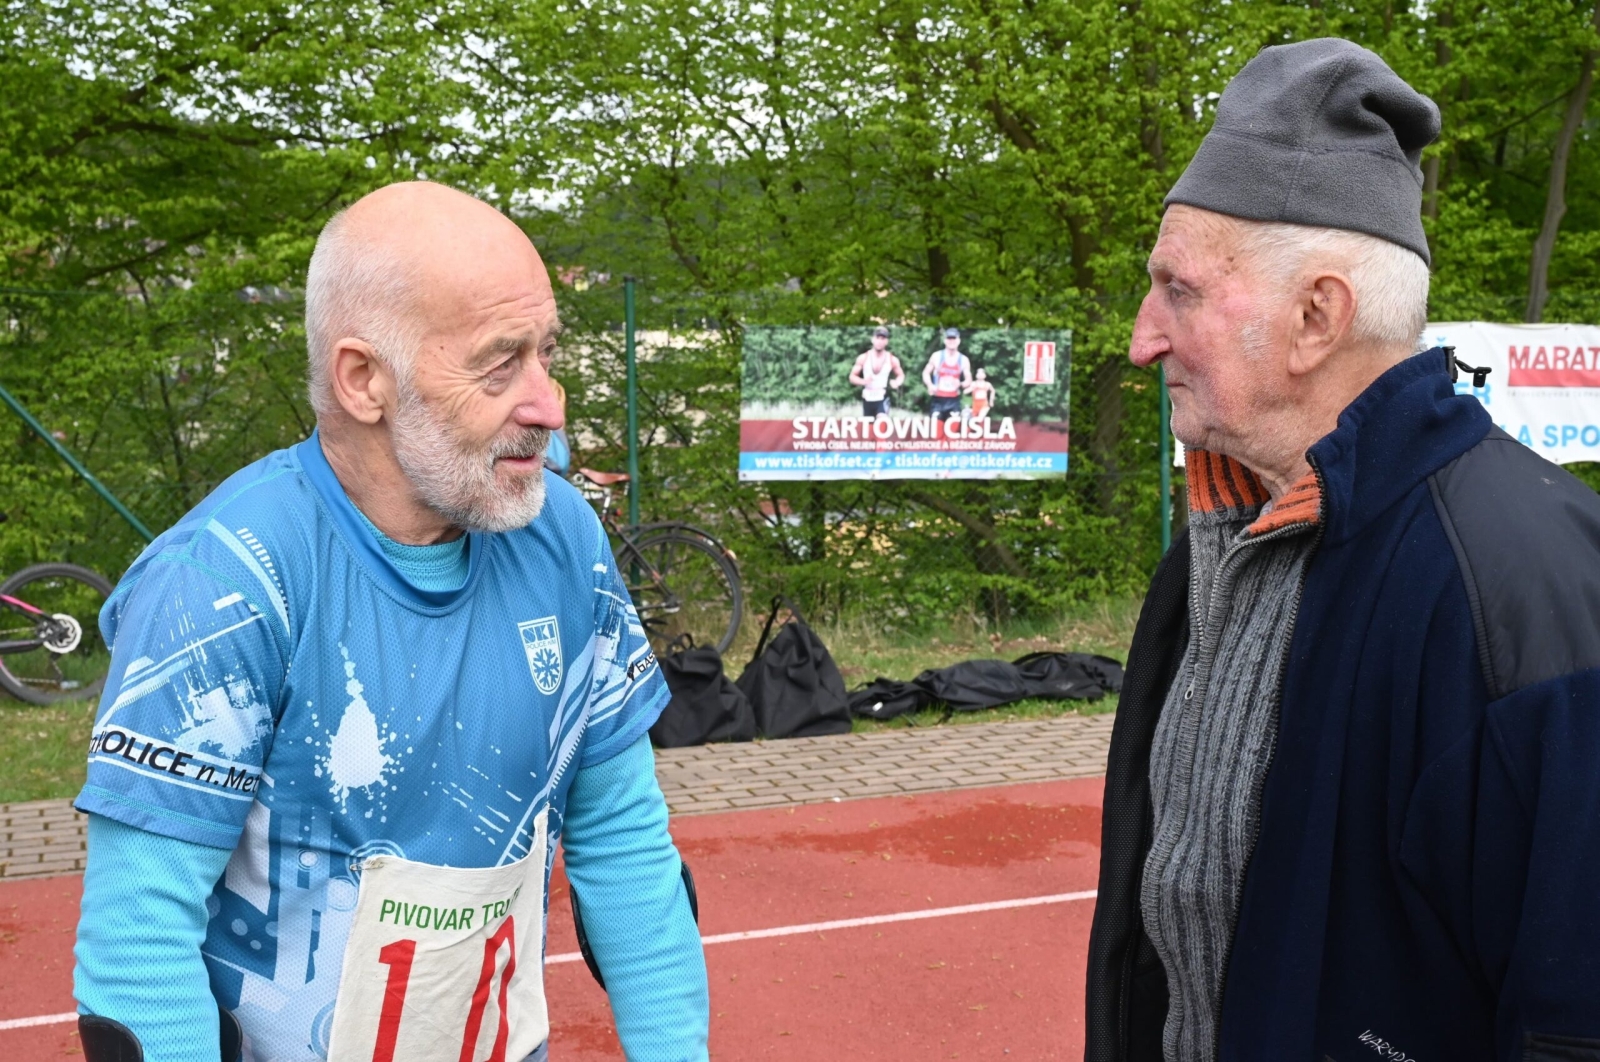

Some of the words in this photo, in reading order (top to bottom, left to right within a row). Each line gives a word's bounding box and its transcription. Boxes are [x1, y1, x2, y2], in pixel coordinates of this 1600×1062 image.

[792, 411, 940, 439] STARTOVNÍ
[943, 411, 1017, 440] ČÍSLA
[1543, 424, 1600, 448] SPO
[754, 454, 882, 468] www.tiskofset.cz
[895, 453, 1053, 469] tiskofset@tiskofset.cz
[522, 623, 556, 644] SKI
[379, 899, 475, 931] PIVOVAR
